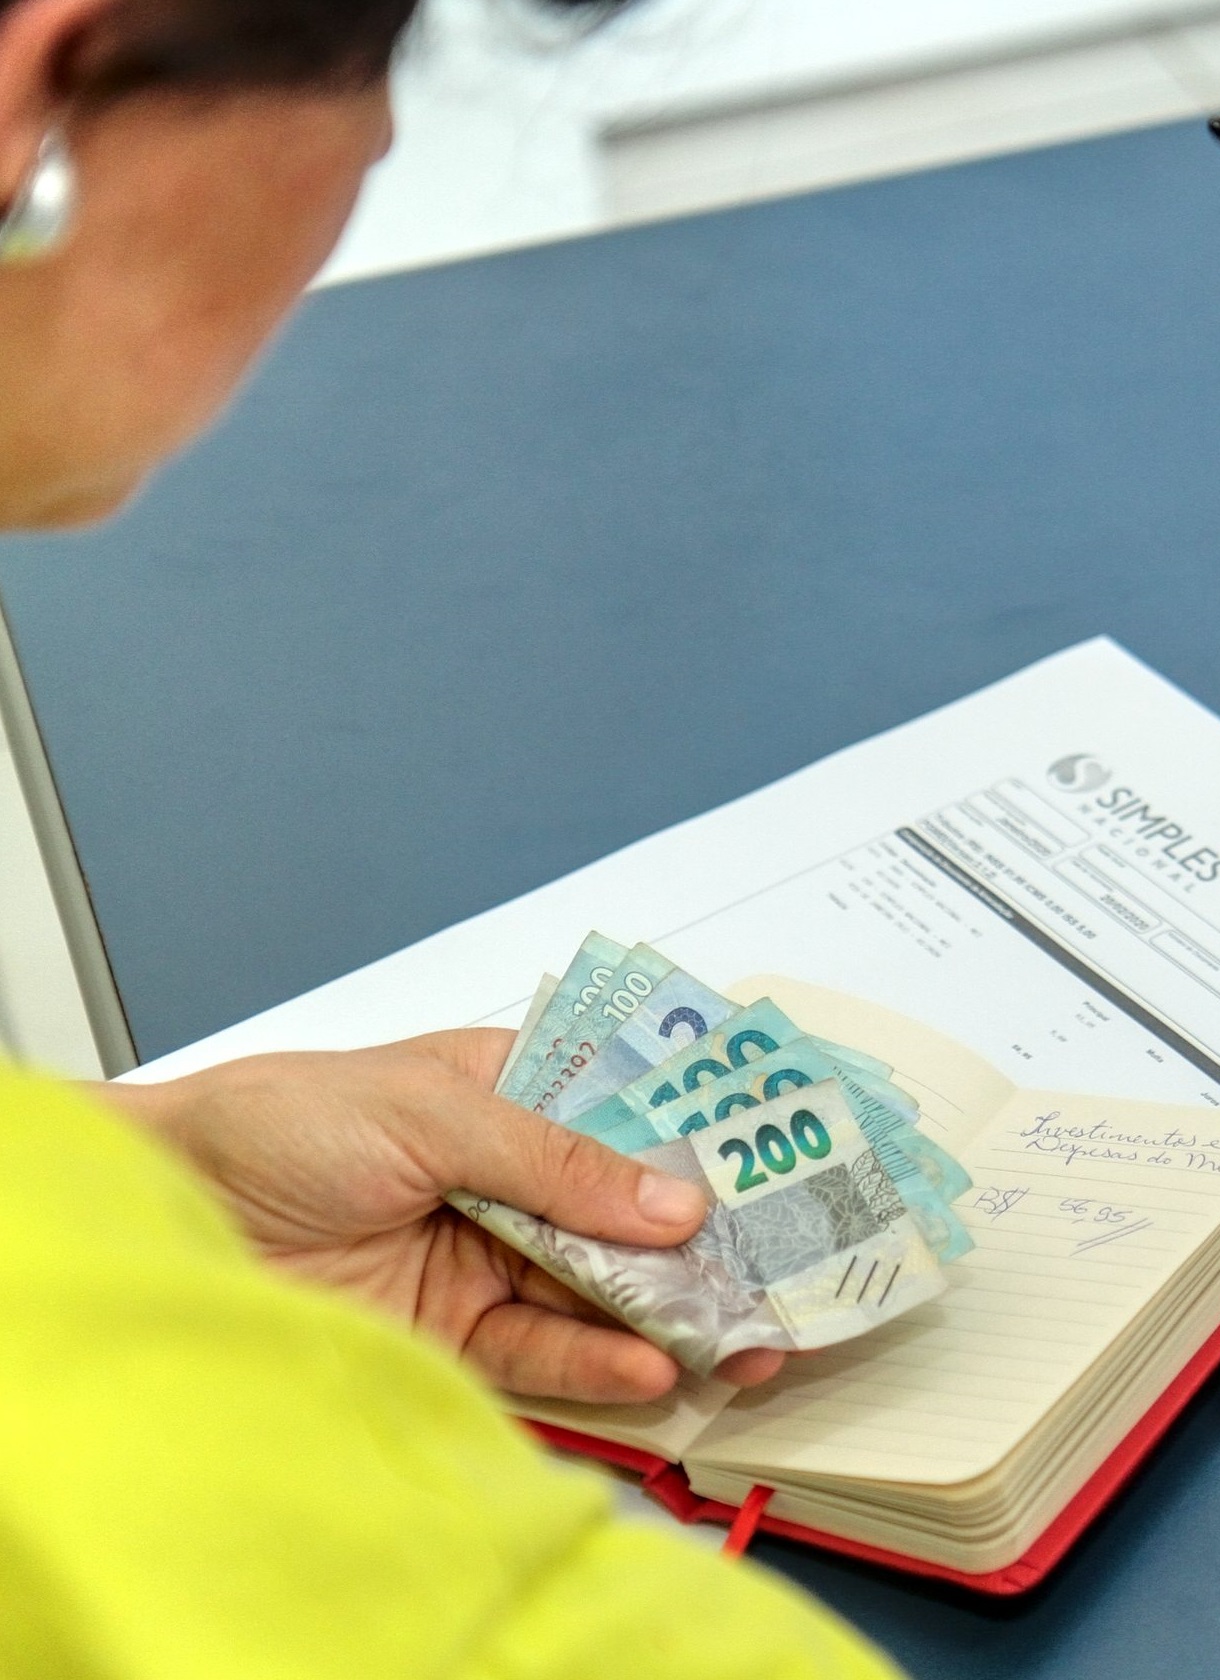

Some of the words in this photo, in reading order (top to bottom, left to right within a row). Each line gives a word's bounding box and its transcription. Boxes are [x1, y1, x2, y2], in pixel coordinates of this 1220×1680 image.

[1078, 803, 1196, 893] NACIONAL
[601, 971, 653, 1024] 100
[717, 1109, 832, 1194] 200
[1020, 1110, 1197, 1149] Investimentos
[1025, 1135, 1138, 1166] Despesas
[1147, 1149, 1173, 1165] do
